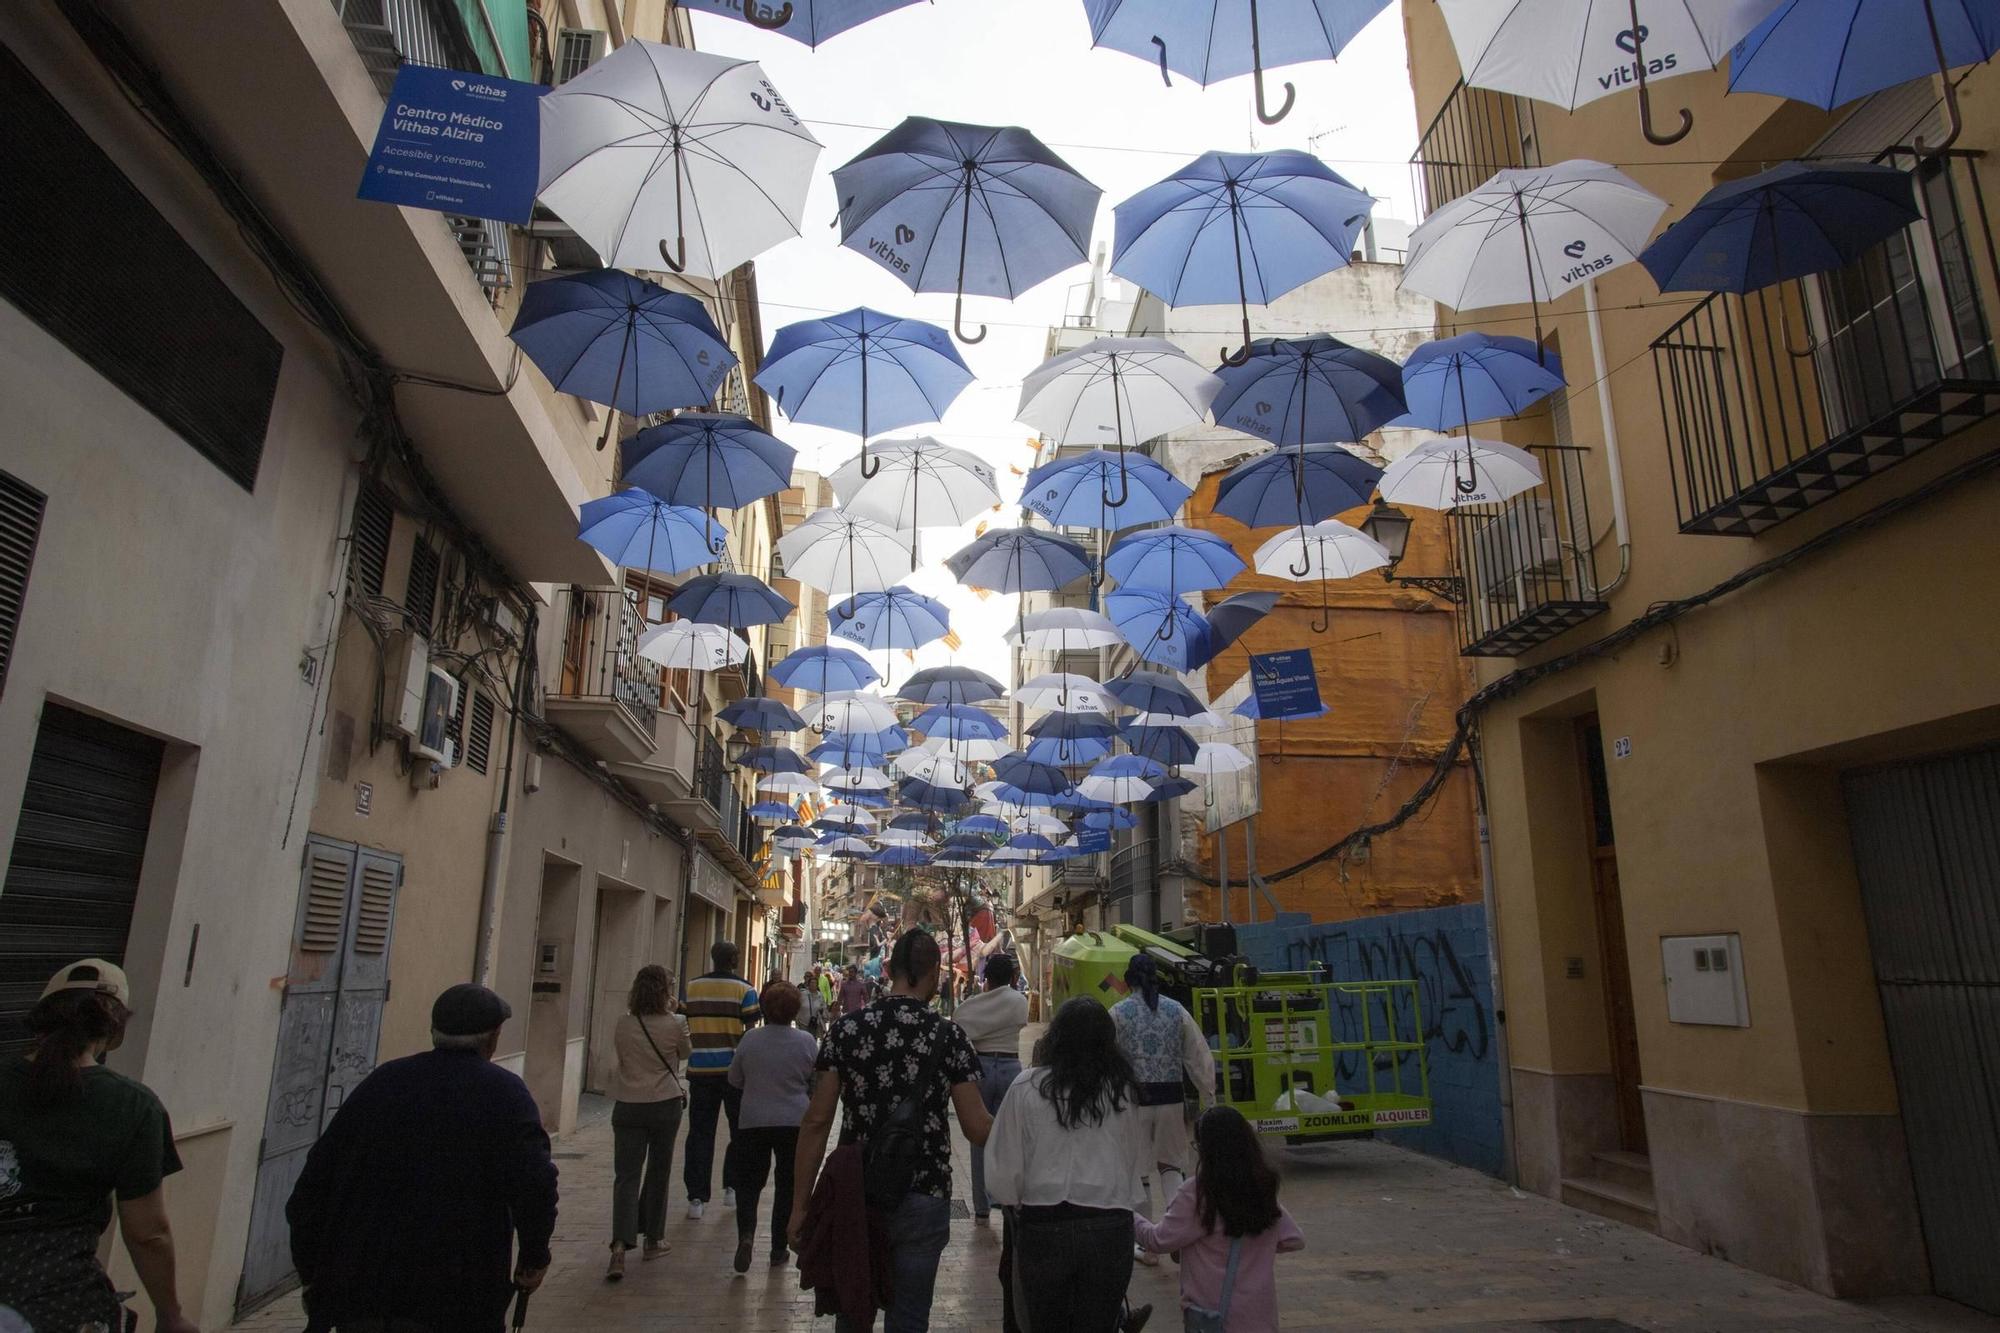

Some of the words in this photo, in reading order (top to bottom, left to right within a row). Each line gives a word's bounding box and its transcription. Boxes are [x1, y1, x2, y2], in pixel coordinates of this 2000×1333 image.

[468, 84, 508, 98] vithas
[759, 79, 800, 126] vithas
[396, 104, 446, 122] Centro
[450, 112, 503, 131] Médico
[393, 118, 439, 136] Vithas
[441, 126, 484, 143] Alzira
[383, 145, 433, 161] Accesible
[434, 154, 441, 163] y
[442, 154, 487, 169] cercano.
[415, 172, 449, 183] Comunitat
[868, 236, 911, 274] vithas
[1561, 253, 1613, 284] vithas
[1236, 415, 1273, 435] vithas
[1450, 493, 1487, 503] vithas
[1030, 499, 1053, 516] vithas
[842, 630, 866, 643] vithas
[1615, 738, 1630, 757] 22
[1257, 1118, 1283, 1126] Maxim
[1304, 1115, 1370, 1127] ZOOMLION
[1375, 1109, 1428, 1122] ALQUILER
